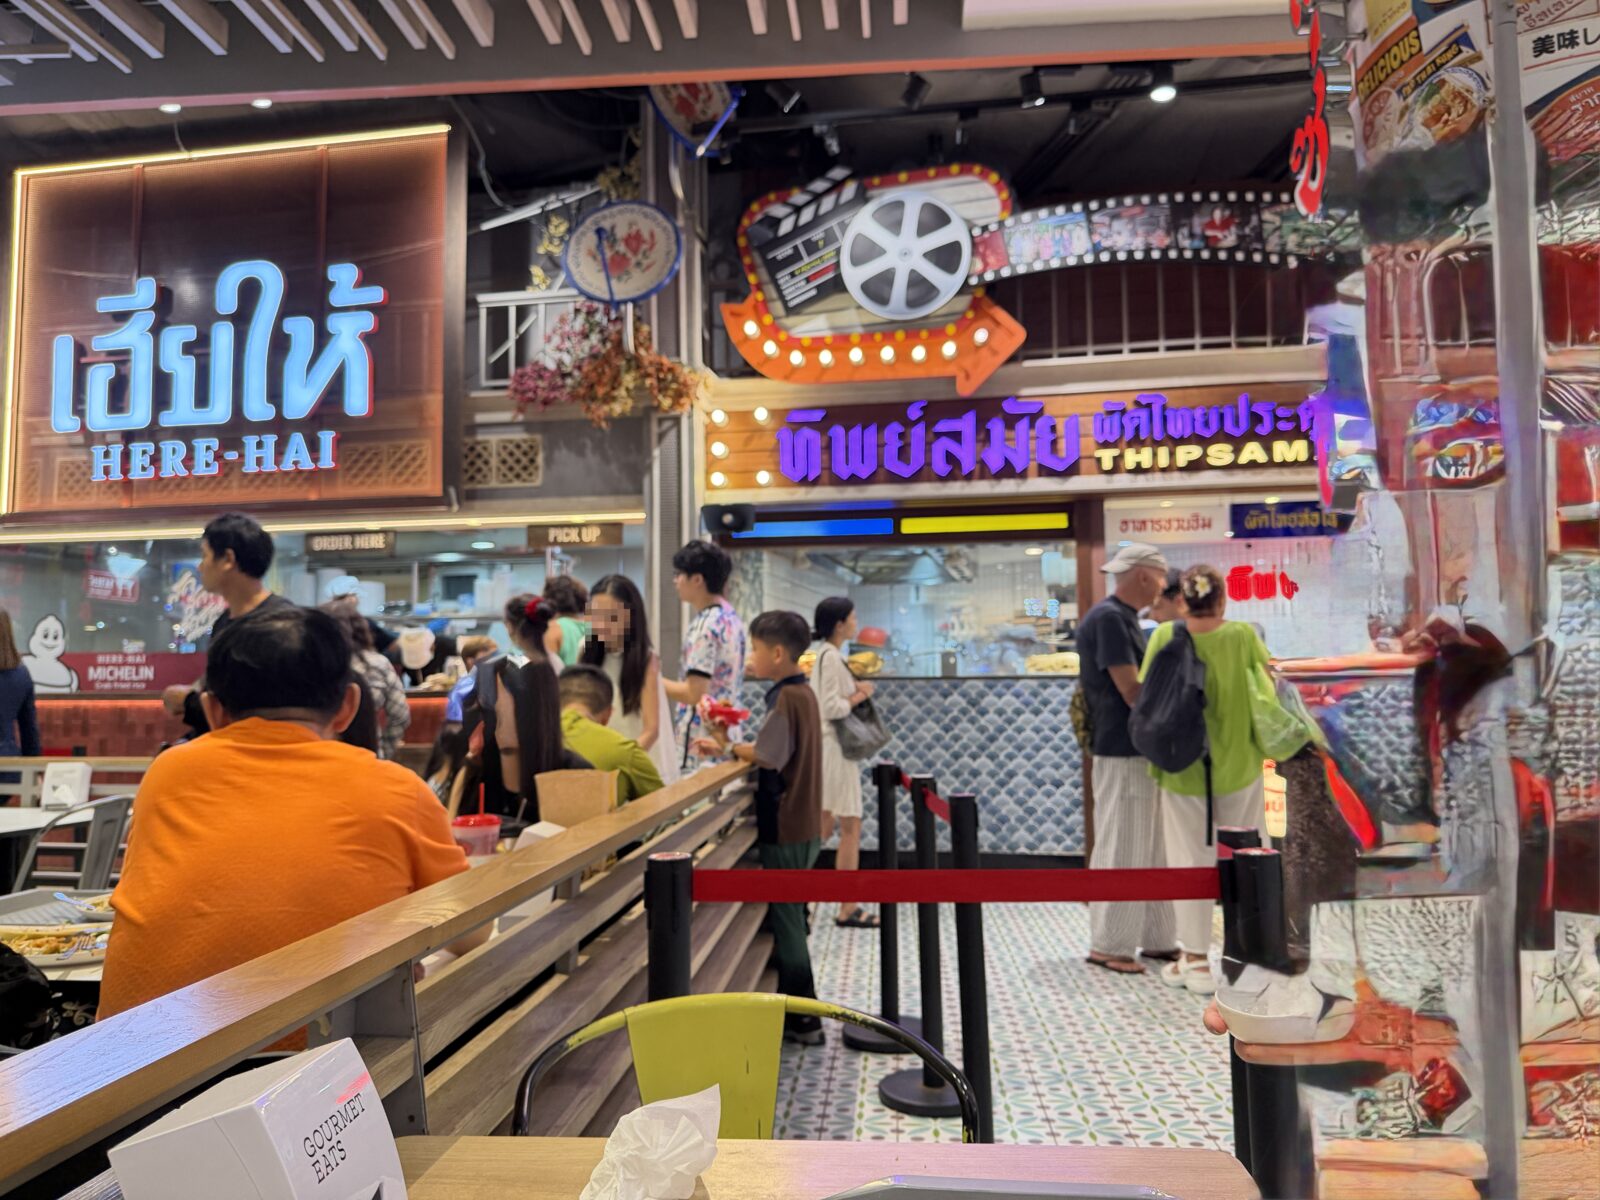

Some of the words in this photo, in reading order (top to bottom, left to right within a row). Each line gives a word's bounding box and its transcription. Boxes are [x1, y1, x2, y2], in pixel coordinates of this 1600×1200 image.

[1357, 30, 1421, 98] DELICIOUS
[52, 259, 386, 434] เฮียให้
[91, 430, 337, 482] HERE-HAI
[775, 396, 1080, 482] ทิพย์สมัย
[1094, 439, 1318, 471] THIPSAM
[312, 534, 352, 552] ORDER
[354, 532, 386, 550] HERE
[549, 526, 579, 543] PICK
[581, 525, 601, 542] UP
[88, 665, 154, 681] MICHELIN
[303, 1093, 365, 1158] GOURMET
[311, 1140, 347, 1185] EATS
